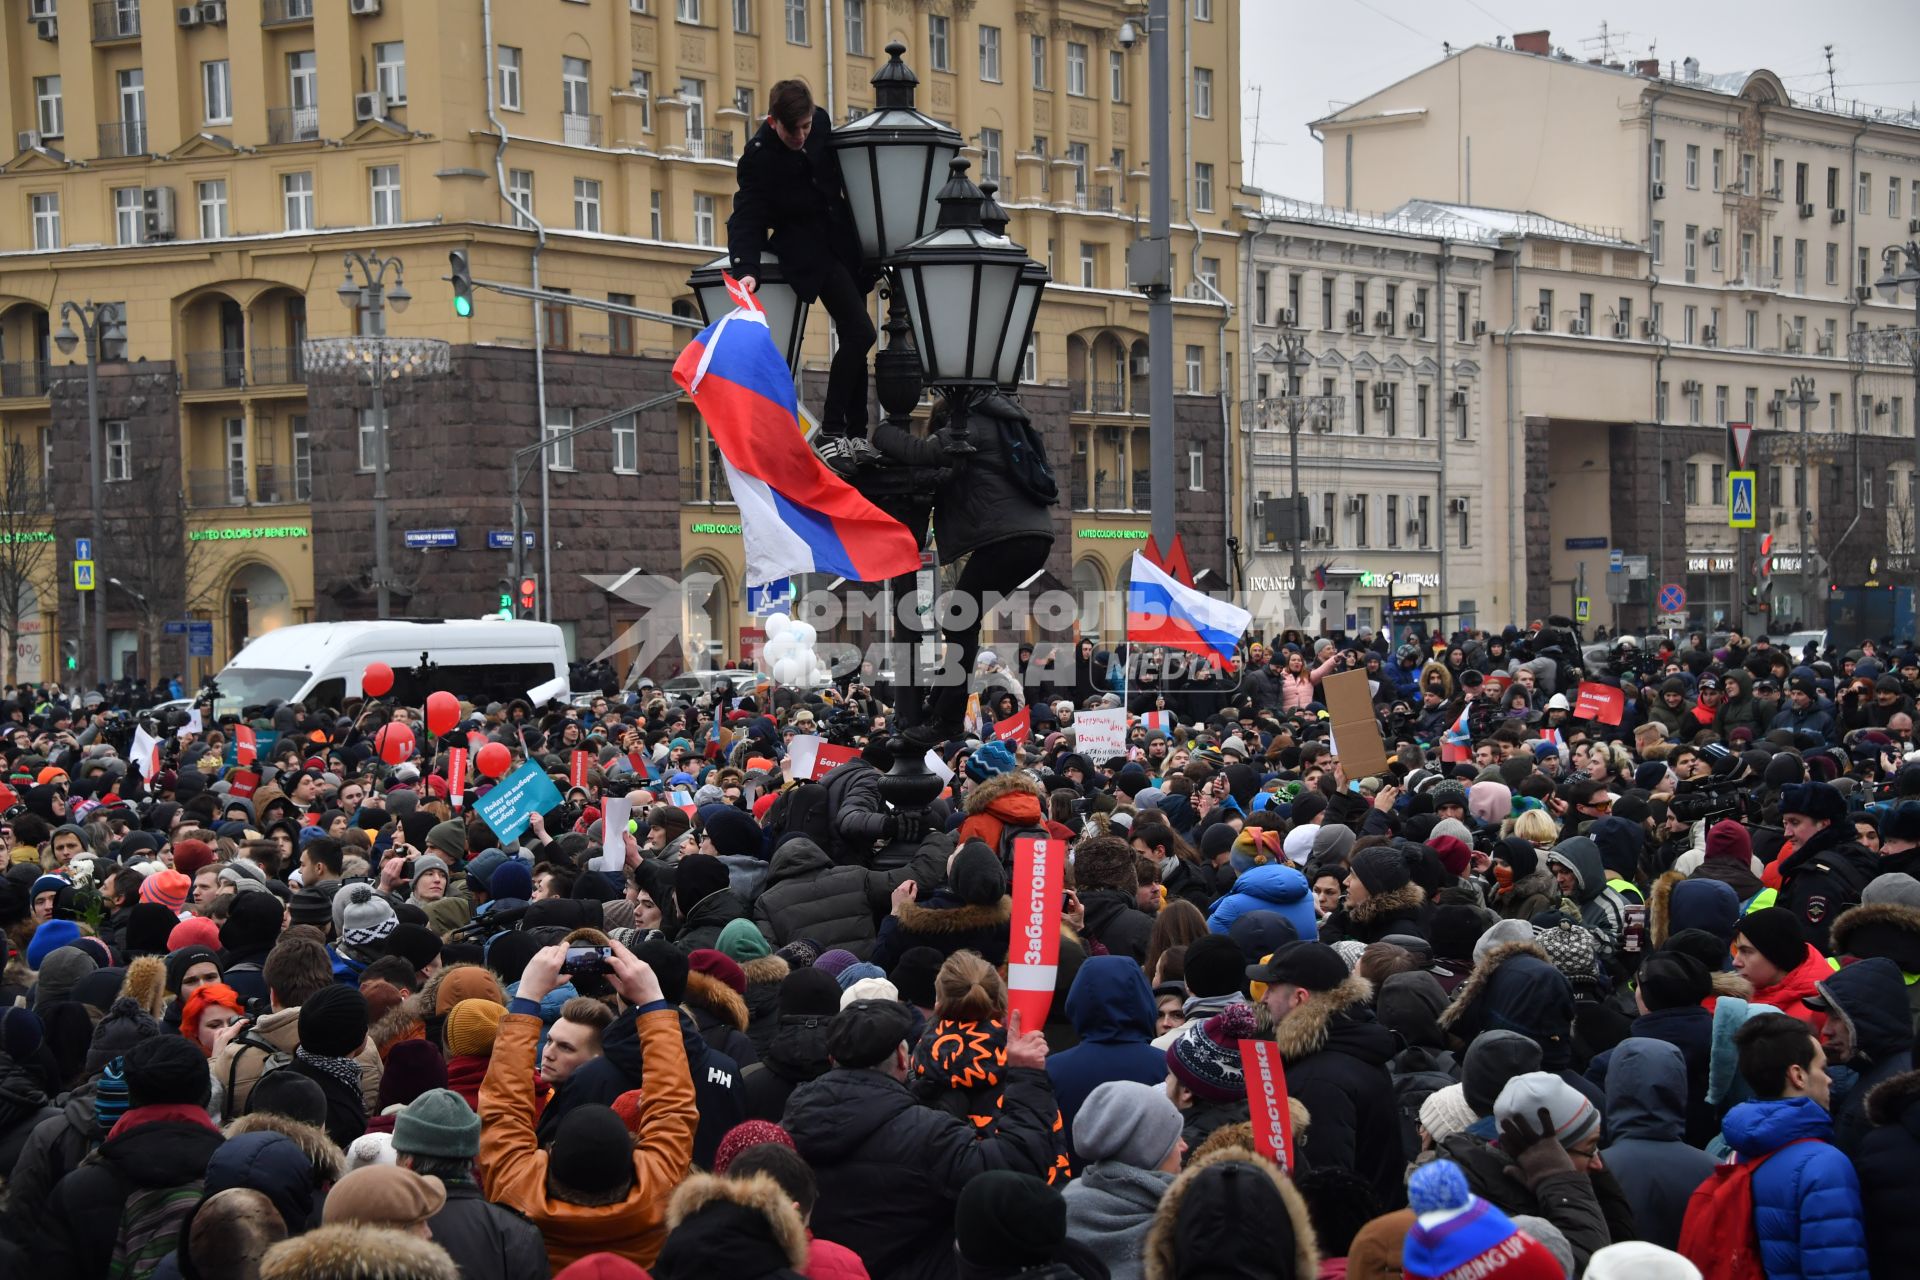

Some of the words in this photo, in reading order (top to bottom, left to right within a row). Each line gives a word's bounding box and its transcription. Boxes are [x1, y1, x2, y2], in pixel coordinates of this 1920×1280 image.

[190, 529, 219, 540] UNITED
[221, 527, 251, 539] COLORS
[253, 527, 264, 538] OF
[265, 525, 307, 538] BENETTON
[692, 523, 715, 533] UNITED
[716, 524, 741, 534] COLORS
[1078, 529, 1096, 538] UNITED
[1096, 530, 1116, 539] COLORS
[1116, 530, 1123, 539] OF
[1124, 530, 1148, 539] BENETTON
[1250, 576, 1295, 591] INCANTO
[820, 757, 836, 767] Без
[483, 796, 505, 815] Пойду
[503, 790, 513, 800] на
[511, 770, 538, 795] выборы,
[489, 804, 508, 821] когда
[505, 790, 525, 807] будет
[494, 806, 517, 826] выбор!
[1024, 839, 1047, 965] Забастовка
